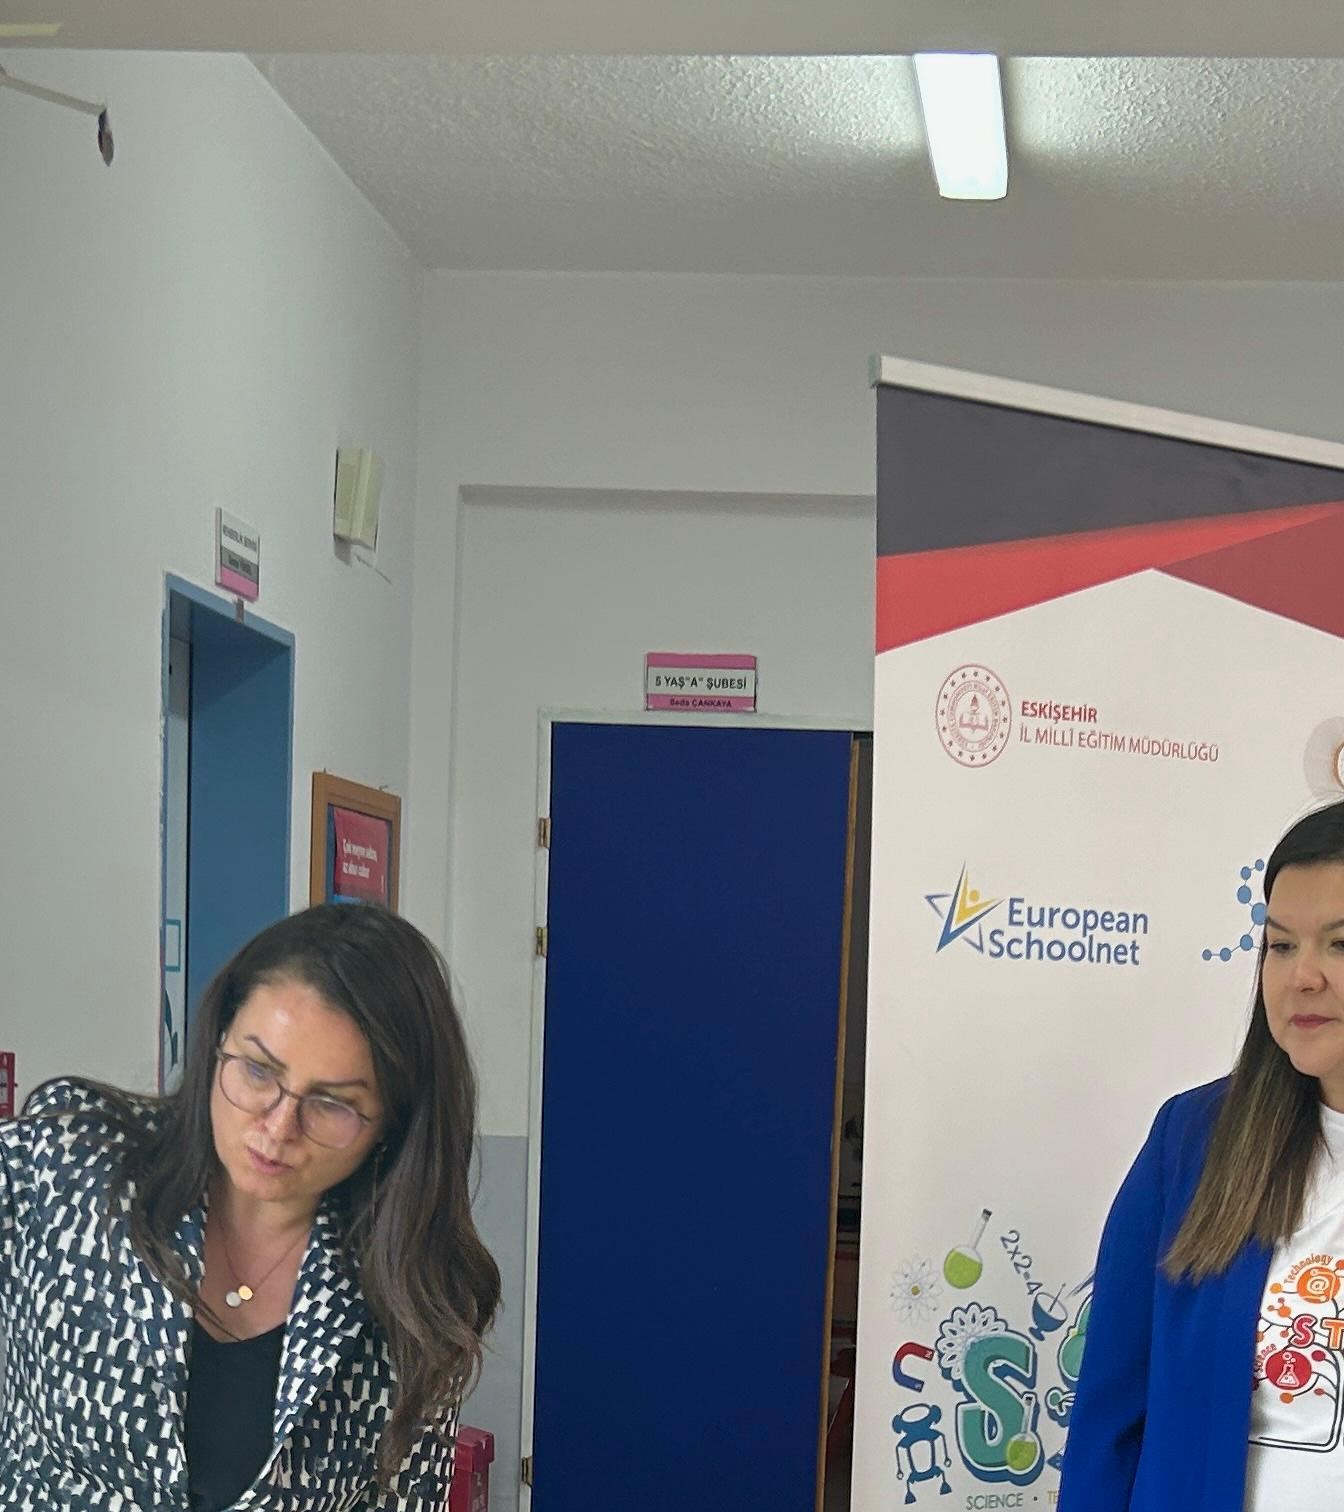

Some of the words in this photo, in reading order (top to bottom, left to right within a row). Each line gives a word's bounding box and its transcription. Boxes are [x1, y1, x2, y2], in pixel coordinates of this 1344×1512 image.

[706, 677, 747, 690] ŞUBESİ
[1021, 700, 1097, 724] ESKİŞEHİR
[1020, 722, 1031, 743] İL
[1078, 730, 1126, 752] EĞİTİM
[1128, 736, 1219, 762] MÜDÜRLÜĞÜ
[1008, 897, 1149, 938] European
[989, 928, 1140, 966] Schoolnet
[1283, 1253, 1334, 1283] Technology
[966, 1492, 1024, 1511] SCIENCE
